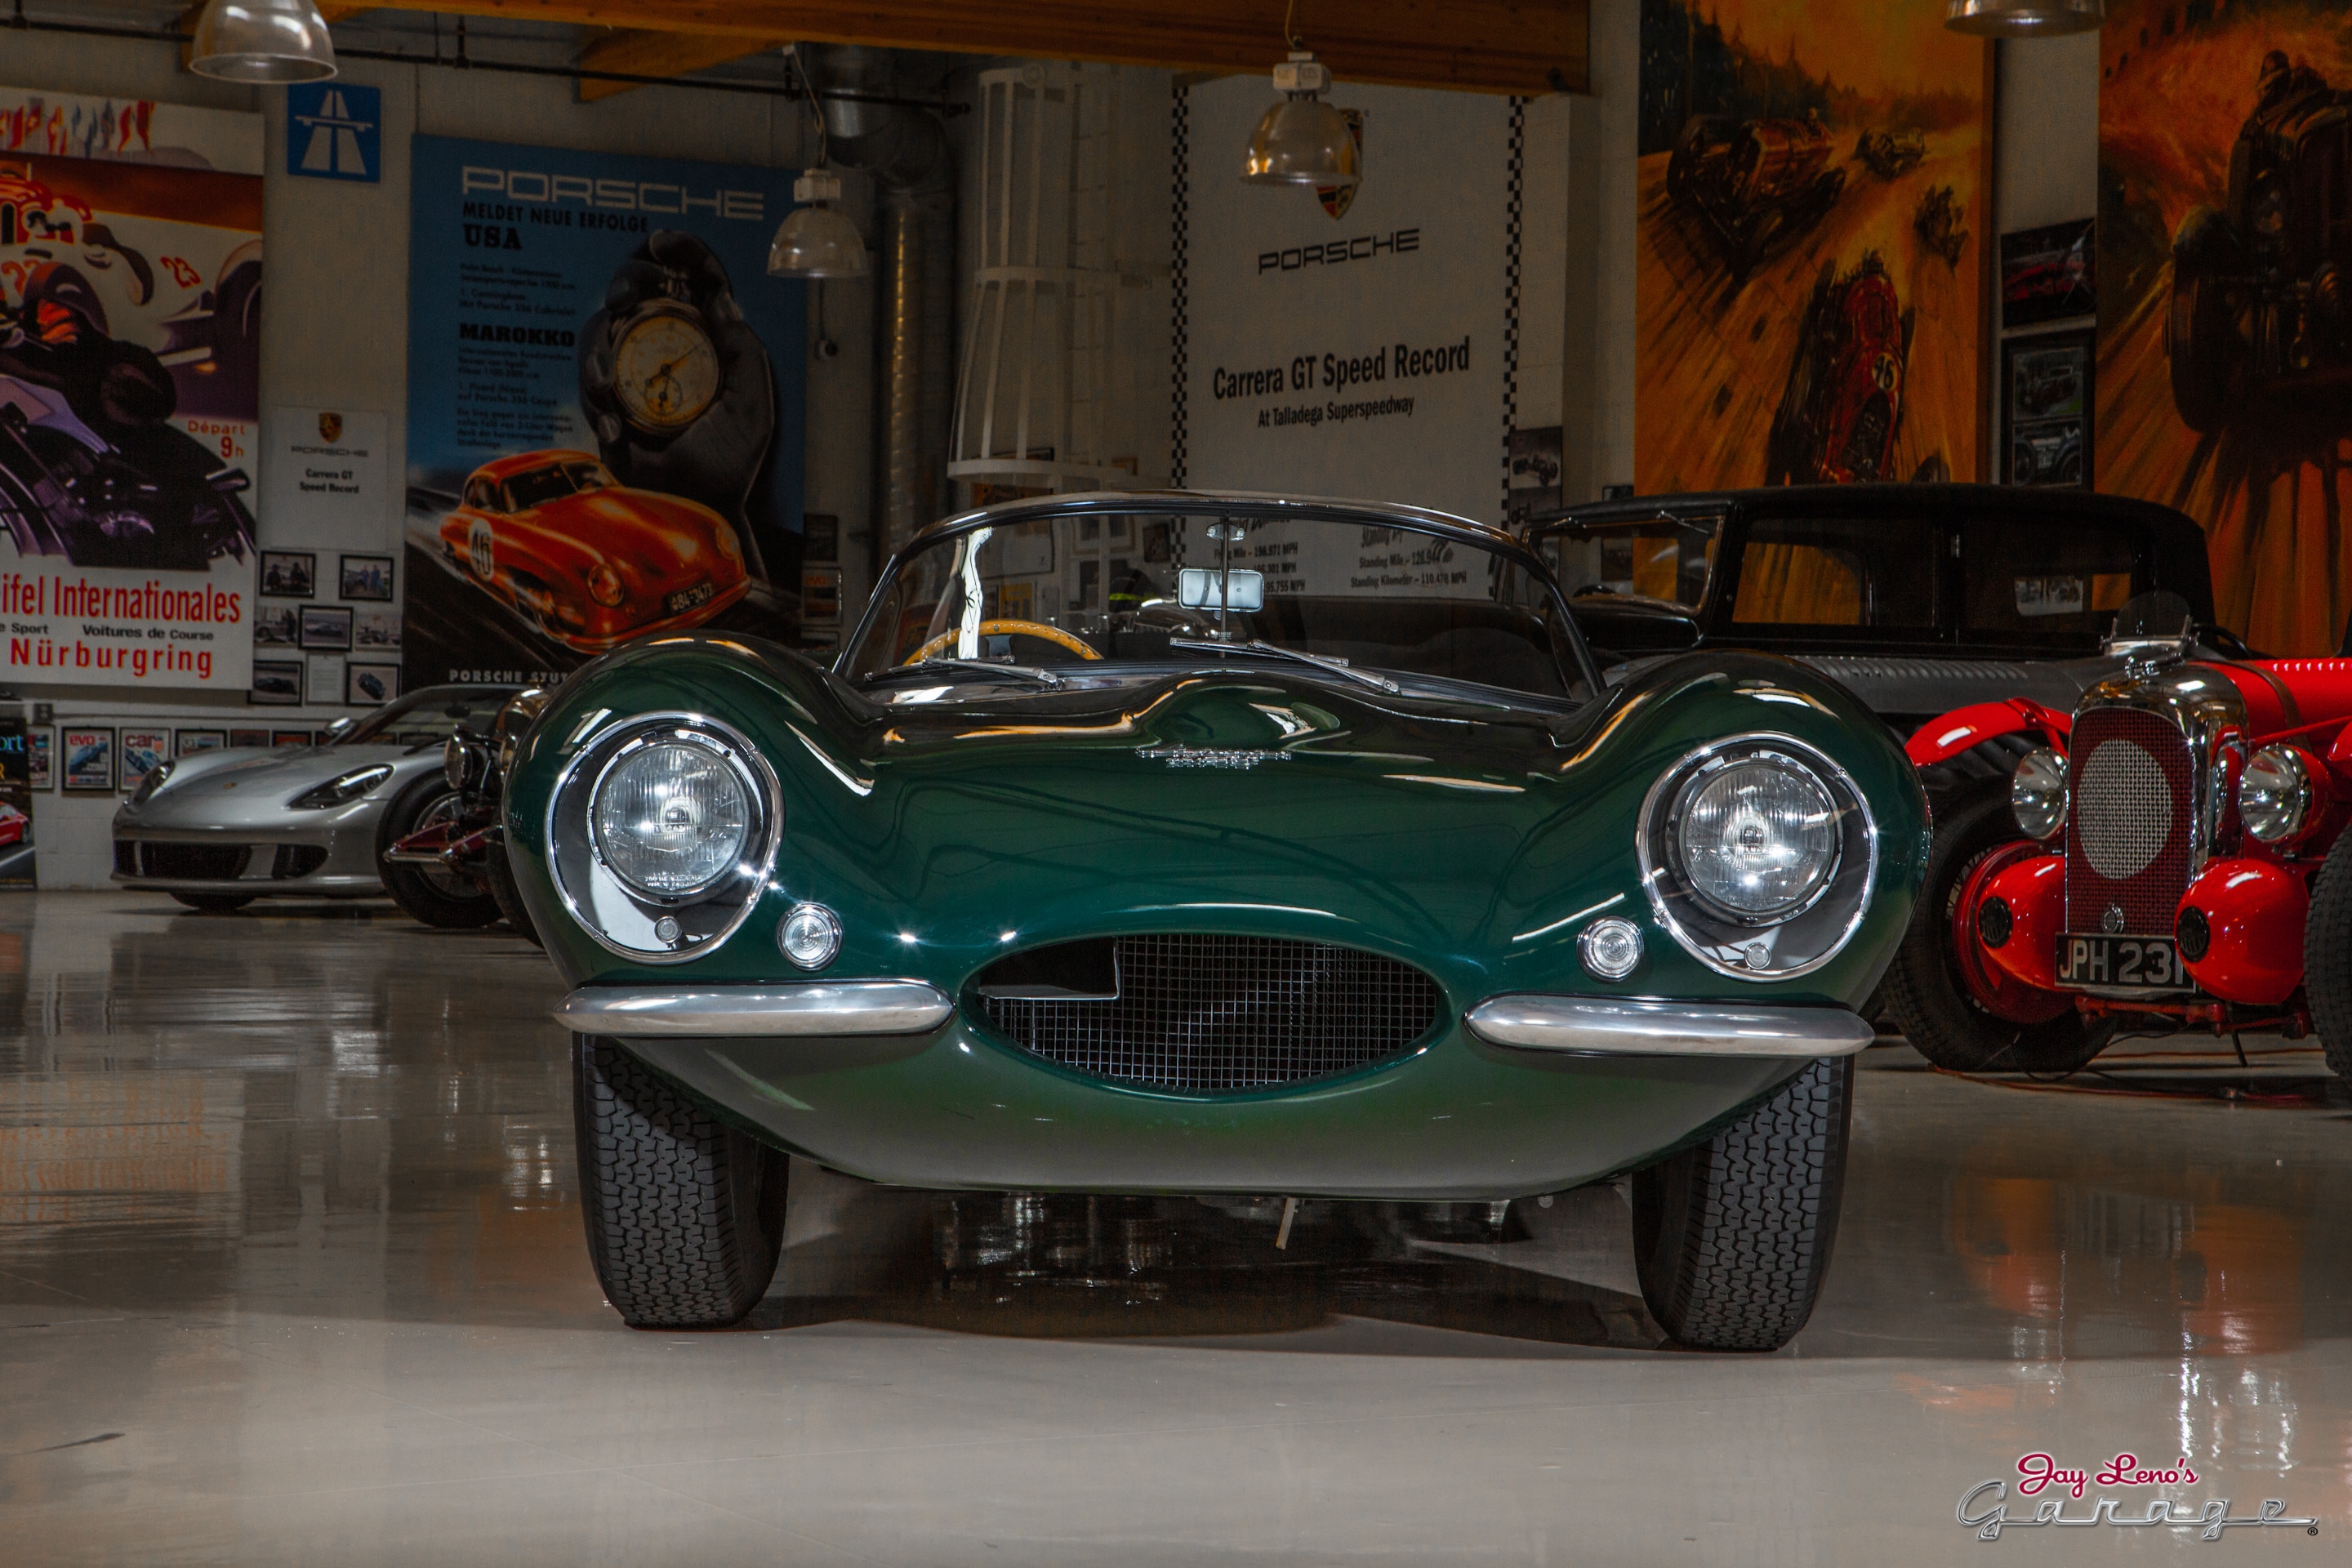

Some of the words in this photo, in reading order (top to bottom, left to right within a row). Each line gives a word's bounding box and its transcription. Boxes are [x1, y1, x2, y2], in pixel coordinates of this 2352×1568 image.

[461, 166, 764, 220] PORSCHE
[462, 203, 523, 222] MELDET
[531, 208, 572, 226] NEUE
[580, 212, 648, 233] ERFOLGE
[463, 223, 523, 250] USA
[1258, 228, 1419, 275] PORSCHE
[460, 323, 576, 347] MAROKKO
[1214, 367, 1283, 399] Carrera
[1291, 355, 1316, 390] GT
[1322, 347, 1386, 393] Speed
[1395, 336, 1470, 378] Record
[1258, 409, 1270, 427] At
[1273, 403, 1323, 426] Talladega
[1326, 395, 1414, 423] Superspeedway
[188, 420, 245, 436] Départ
[220, 436, 233, 458] 9
[291, 445, 368, 457] PORSCHE
[305, 468, 339, 479] Carrera
[341, 470, 353, 480] GT
[1282, 542, 1298, 555] MPH
[1265, 581, 1289, 594] 95.755
[1290, 579, 1306, 592] MPH
[1351, 575, 1379, 589] Standing
[1451, 572, 1467, 583] MPH
[54, 576, 242, 623] Internationales
[11, 621, 49, 635] Sport
[82, 624, 142, 639] Voitures
[148, 626, 165, 639] de
[170, 629, 214, 641] Course
[11, 637, 212, 679] Nürburgring
[449, 668, 523, 684] PORSCHE
[531, 670, 571, 684] STUT
[69, 735, 96, 746] evo
[125, 735, 155, 747] car
[2059, 937, 2109, 982] JPH
